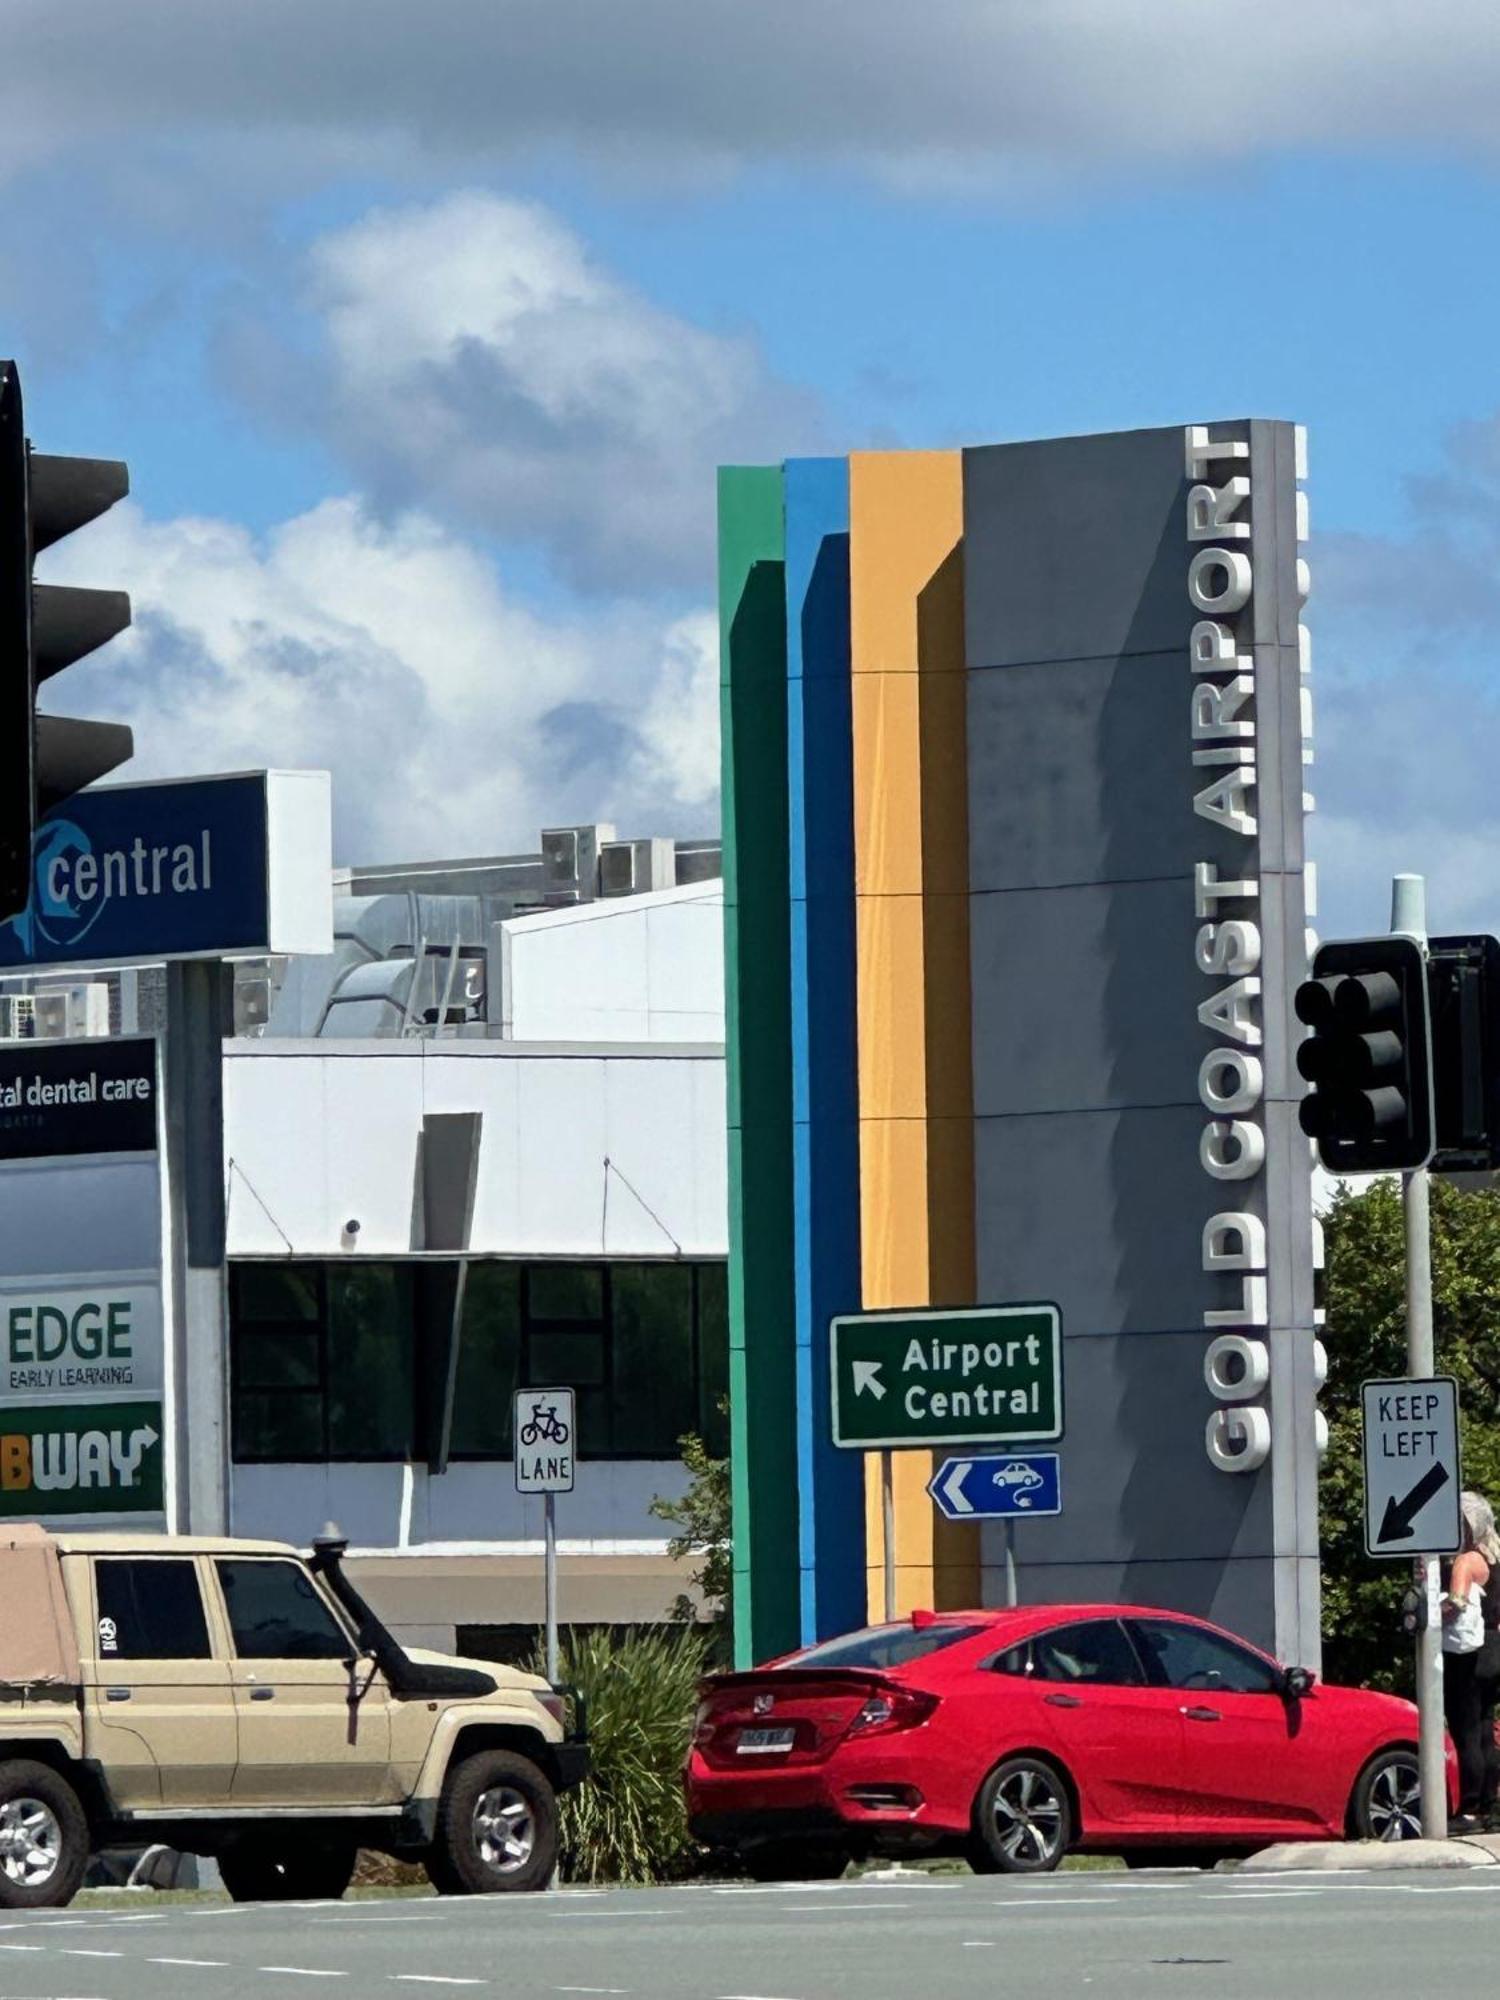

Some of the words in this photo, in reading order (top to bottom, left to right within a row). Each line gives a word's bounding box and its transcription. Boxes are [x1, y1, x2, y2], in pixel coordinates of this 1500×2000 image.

[1184, 425, 1257, 836] AIRPORT
[48, 829, 211, 904] central
[1195, 861, 1265, 1181] COAST
[26, 1071, 97, 1107] dental
[102, 1077, 151, 1101] care
[8, 1301, 133, 1364] EDGE
[1202, 1211, 1271, 1473] GOLD
[901, 1334, 1041, 1377] Airport
[10, 1367, 55, 1389] EARLY
[58, 1365, 134, 1387] LEARNING
[904, 1381, 1040, 1420] Central
[1378, 1394, 1440, 1422] KEEP
[1382, 1430, 1439, 1458] LEFT
[520, 1456, 570, 1480] LANE
